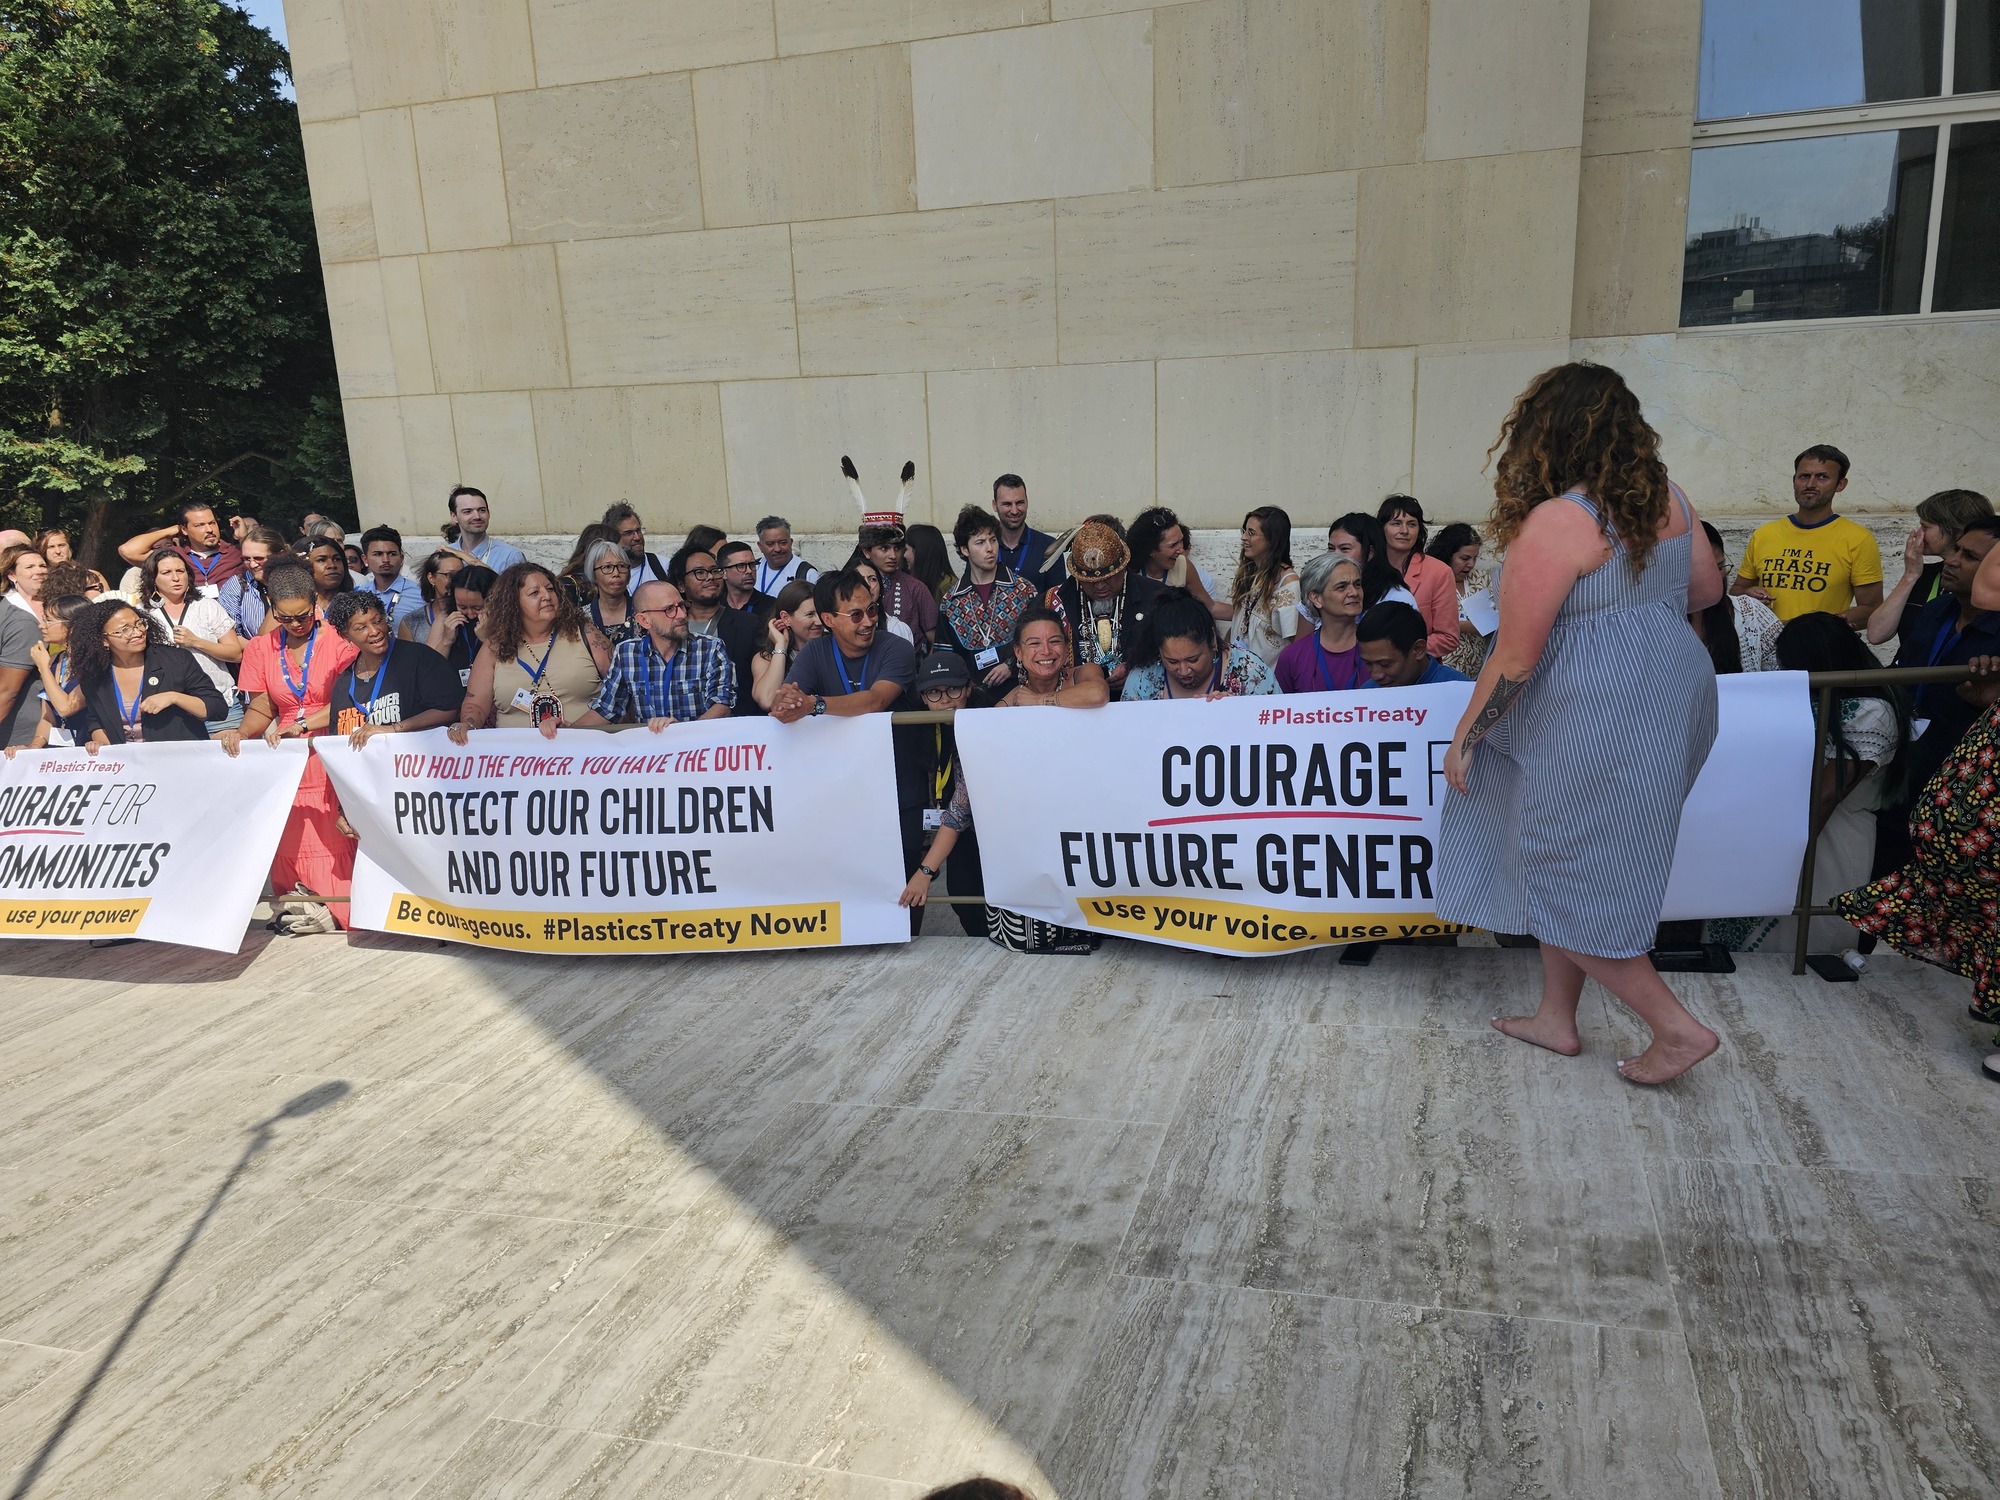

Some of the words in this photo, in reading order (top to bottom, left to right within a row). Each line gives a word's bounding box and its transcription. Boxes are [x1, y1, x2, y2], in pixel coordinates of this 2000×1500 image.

[1763, 558, 1832, 576] TRASH
[1781, 549, 1802, 558] I'M
[1804, 550, 1813, 558] A
[1762, 573, 1827, 592] HERO
[1258, 706, 1428, 726] #PlasticsTreaty
[39, 761, 125, 775] #PlasticsTreaty
[394, 754, 425, 778] YOU
[427, 756, 474, 779] HOLD
[477, 755, 510, 778] THE
[509, 756, 574, 777] POWER.
[580, 756, 620, 775] YOU
[617, 753, 673, 774] HAVE
[674, 748, 711, 772] THE
[714, 744, 772, 772] DUTY.
[1162, 741, 1408, 807] COURAGE
[92, 784, 156, 826] FOR
[394, 790, 519, 836] PROTECT
[527, 789, 590, 836] OUR
[600, 786, 774, 835] CHILDREN
[448, 850, 501, 895] AND
[509, 850, 571, 897] OUR
[580, 850, 717, 897] FUTURE
[1060, 831, 1243, 890] FUTURE
[6, 910, 37, 923] use
[36, 910, 83, 929] your
[80, 908, 139, 930] power
[397, 900, 421, 922] Be
[427, 909, 531, 940] courageous.
[543, 918, 742, 944] #PlasticsTreaty
[751, 909, 827, 936] Now!
[1092, 901, 1146, 921] Use
[1153, 906, 1217, 931] your
[1224, 914, 1318, 941] voice,
[1330, 925, 1388, 938] use
